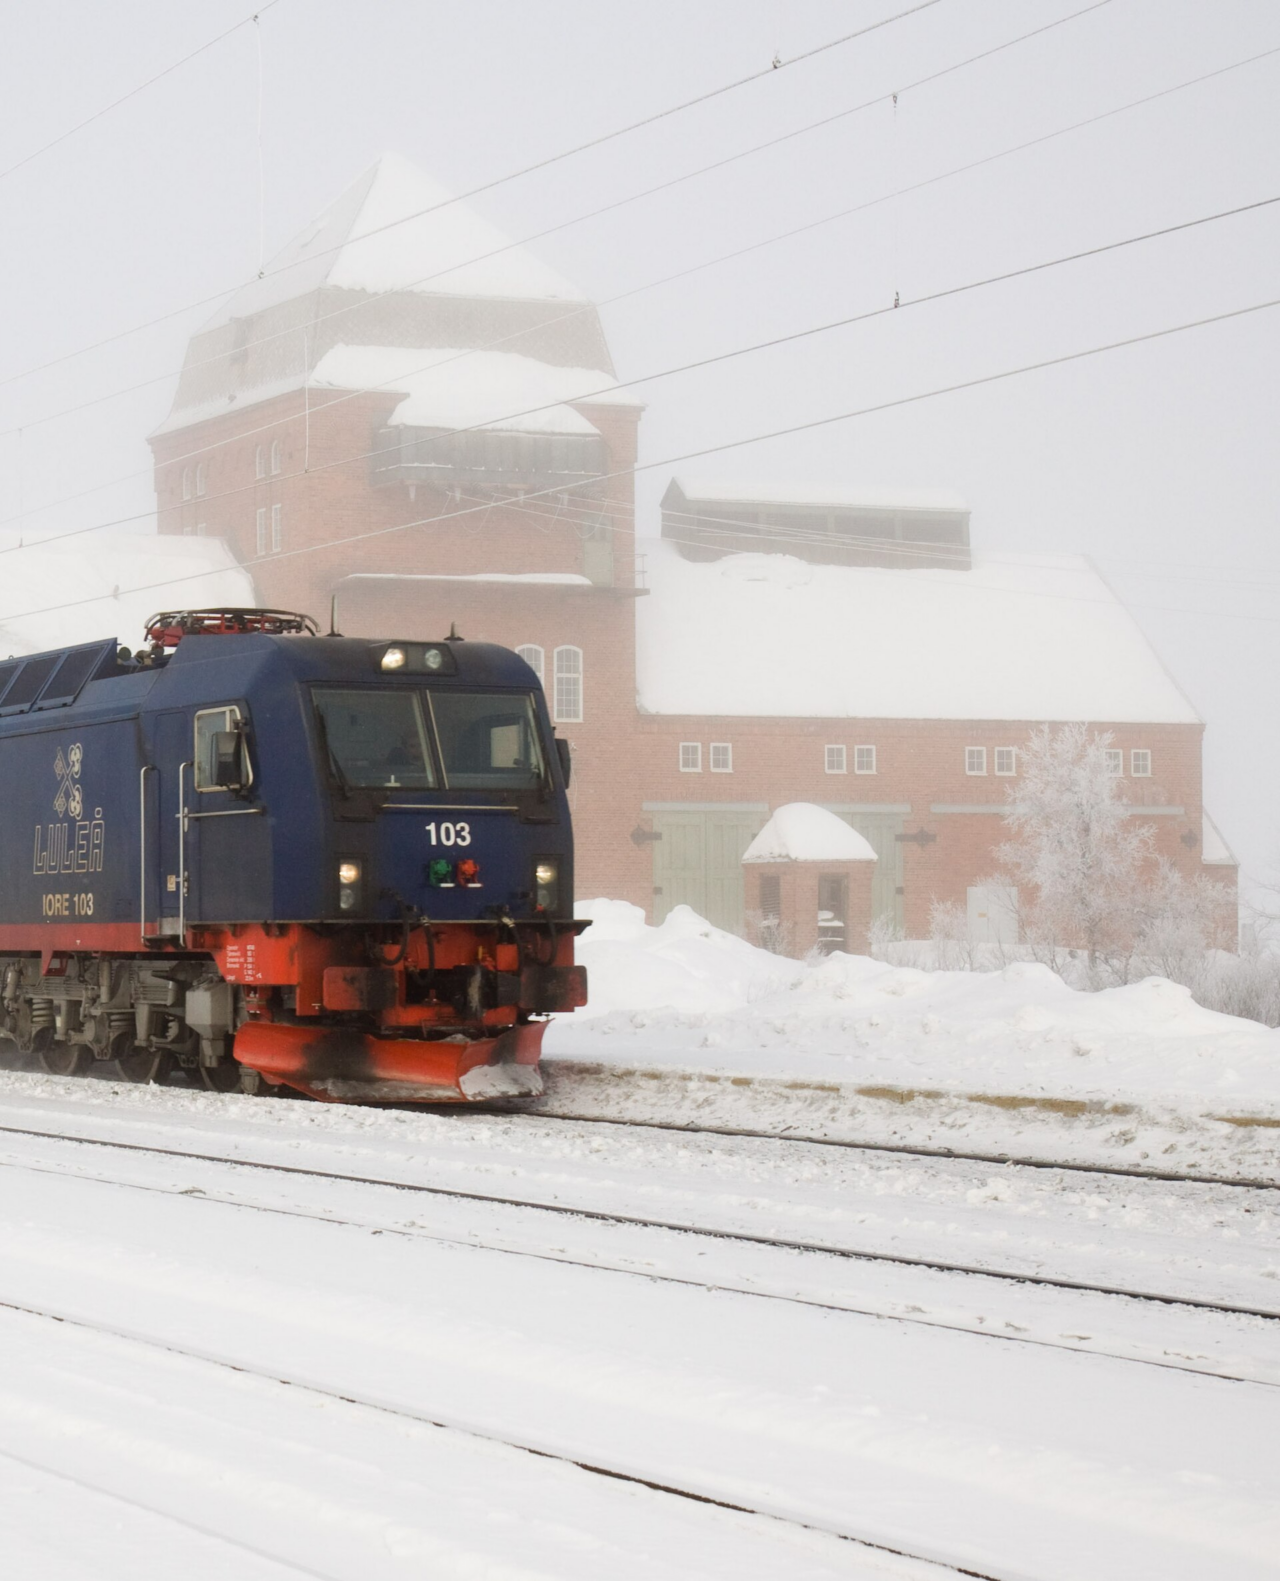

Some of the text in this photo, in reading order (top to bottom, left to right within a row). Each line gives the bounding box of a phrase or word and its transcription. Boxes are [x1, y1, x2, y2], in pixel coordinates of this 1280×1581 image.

[33, 807, 105, 874] LULEÅ
[425, 822, 471, 846] 103
[42, 893, 94, 917] IORE 103
